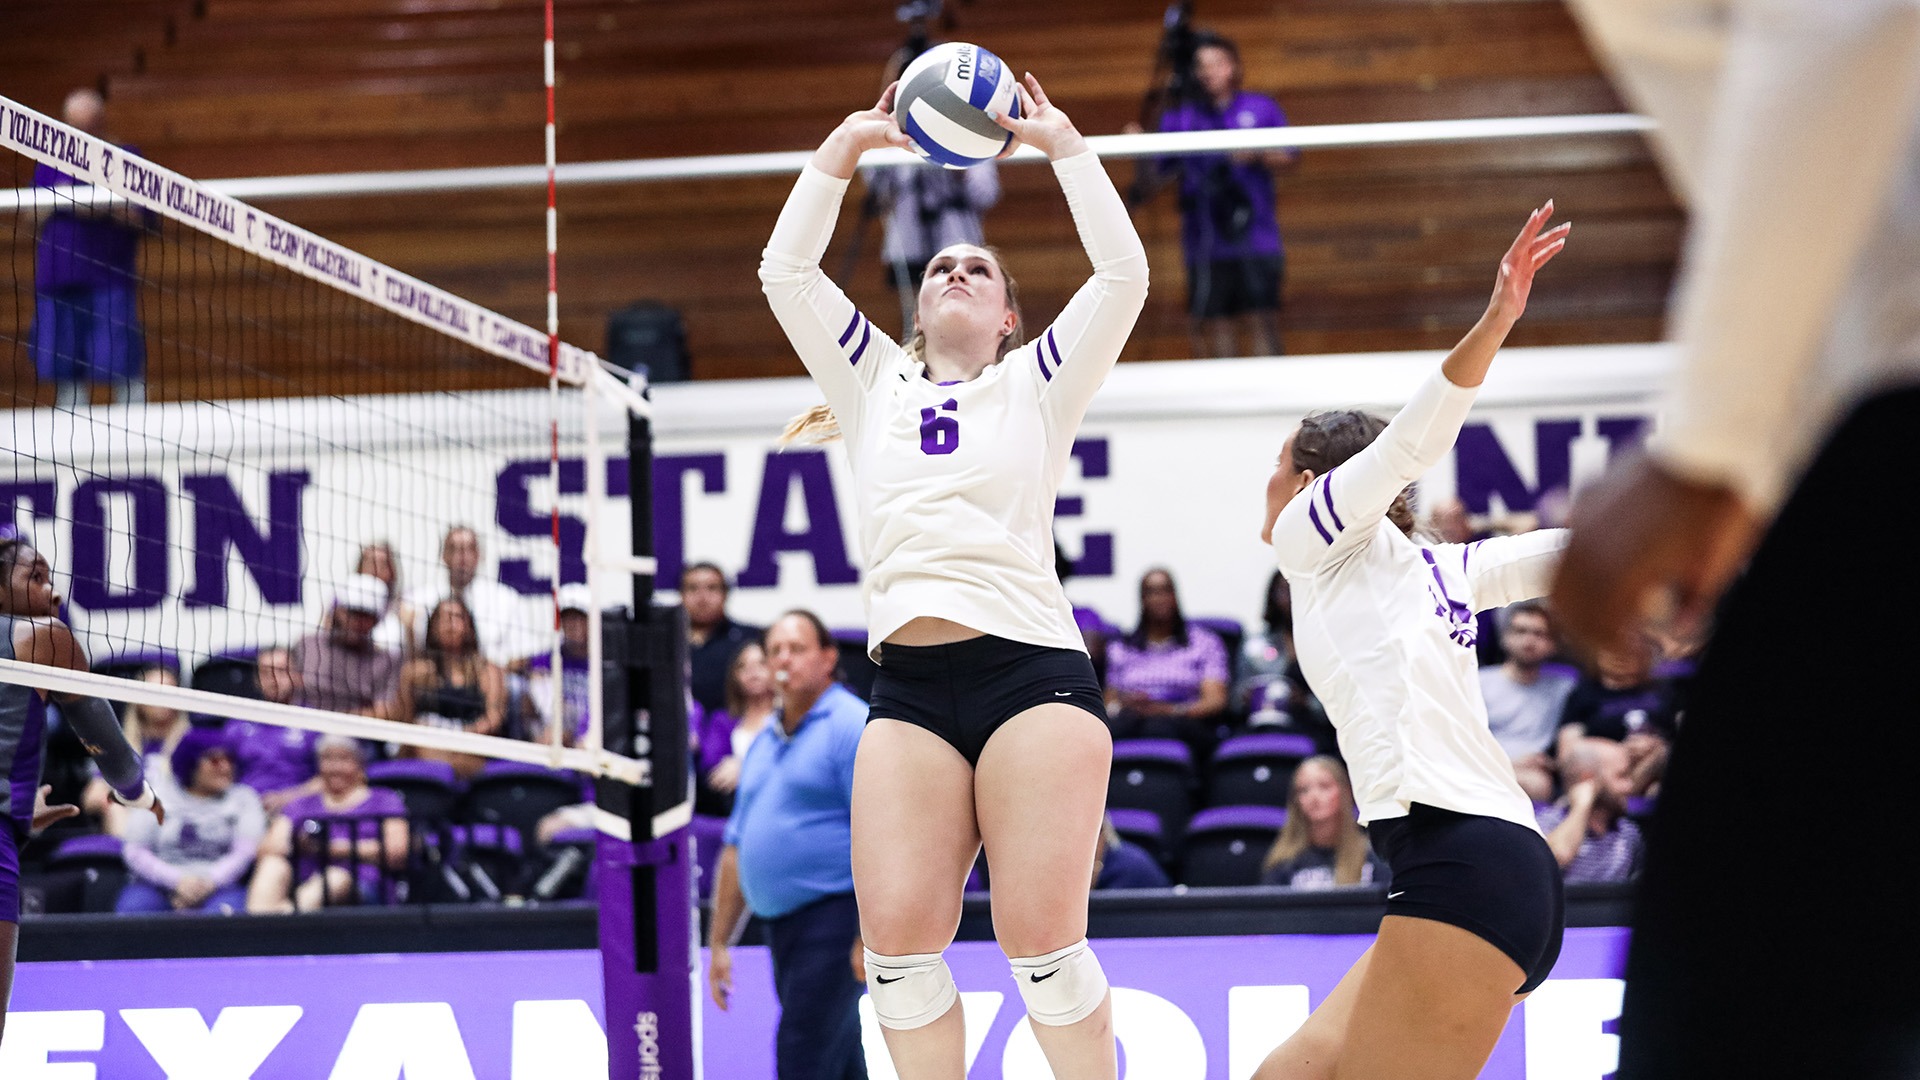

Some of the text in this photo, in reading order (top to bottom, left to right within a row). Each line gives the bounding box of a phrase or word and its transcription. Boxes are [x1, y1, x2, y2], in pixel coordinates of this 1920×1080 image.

[9, 109, 90, 172] VOLLEYBALL
[123, 159, 163, 203] TEXAN
[166, 178, 235, 234] VOLLEYBALL
[920, 398, 959, 455] 6
